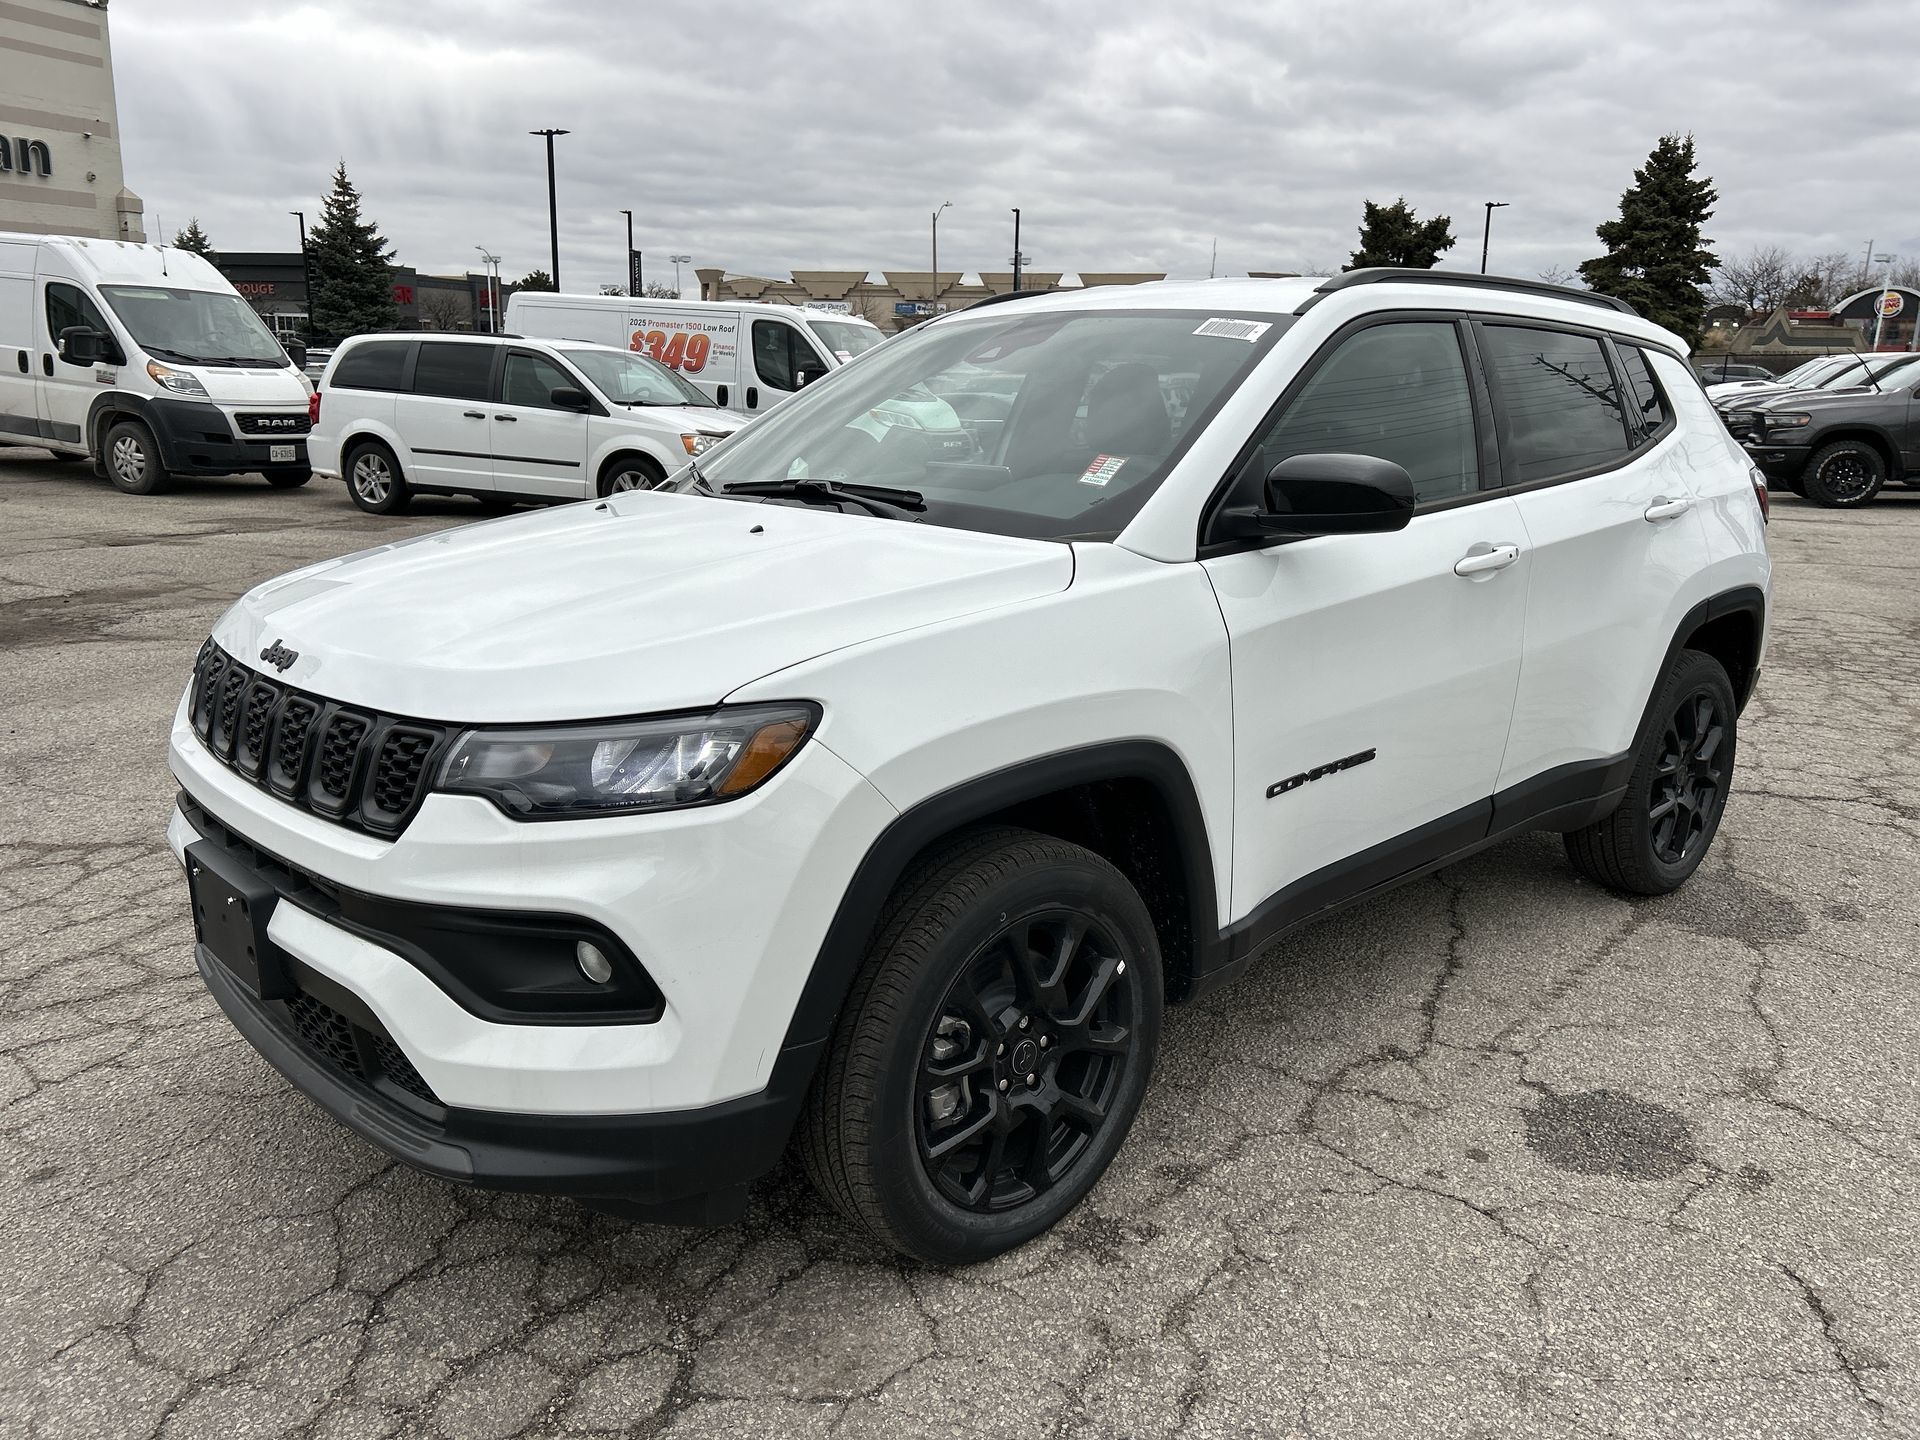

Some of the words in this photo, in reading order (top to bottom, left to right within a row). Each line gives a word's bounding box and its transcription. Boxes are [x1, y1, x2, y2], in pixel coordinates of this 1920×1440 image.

[629, 318, 647, 327] 2025
[647, 319, 684, 329] Promaster
[685, 322, 702, 330] 1500
[703, 323, 717, 332] Low
[718, 324, 735, 333] Roof
[629, 329, 711, 374] $349
[713, 342, 735, 351] Finance
[260, 638, 299, 673] Jeep
[1266, 747, 1376, 799] COMPASS
